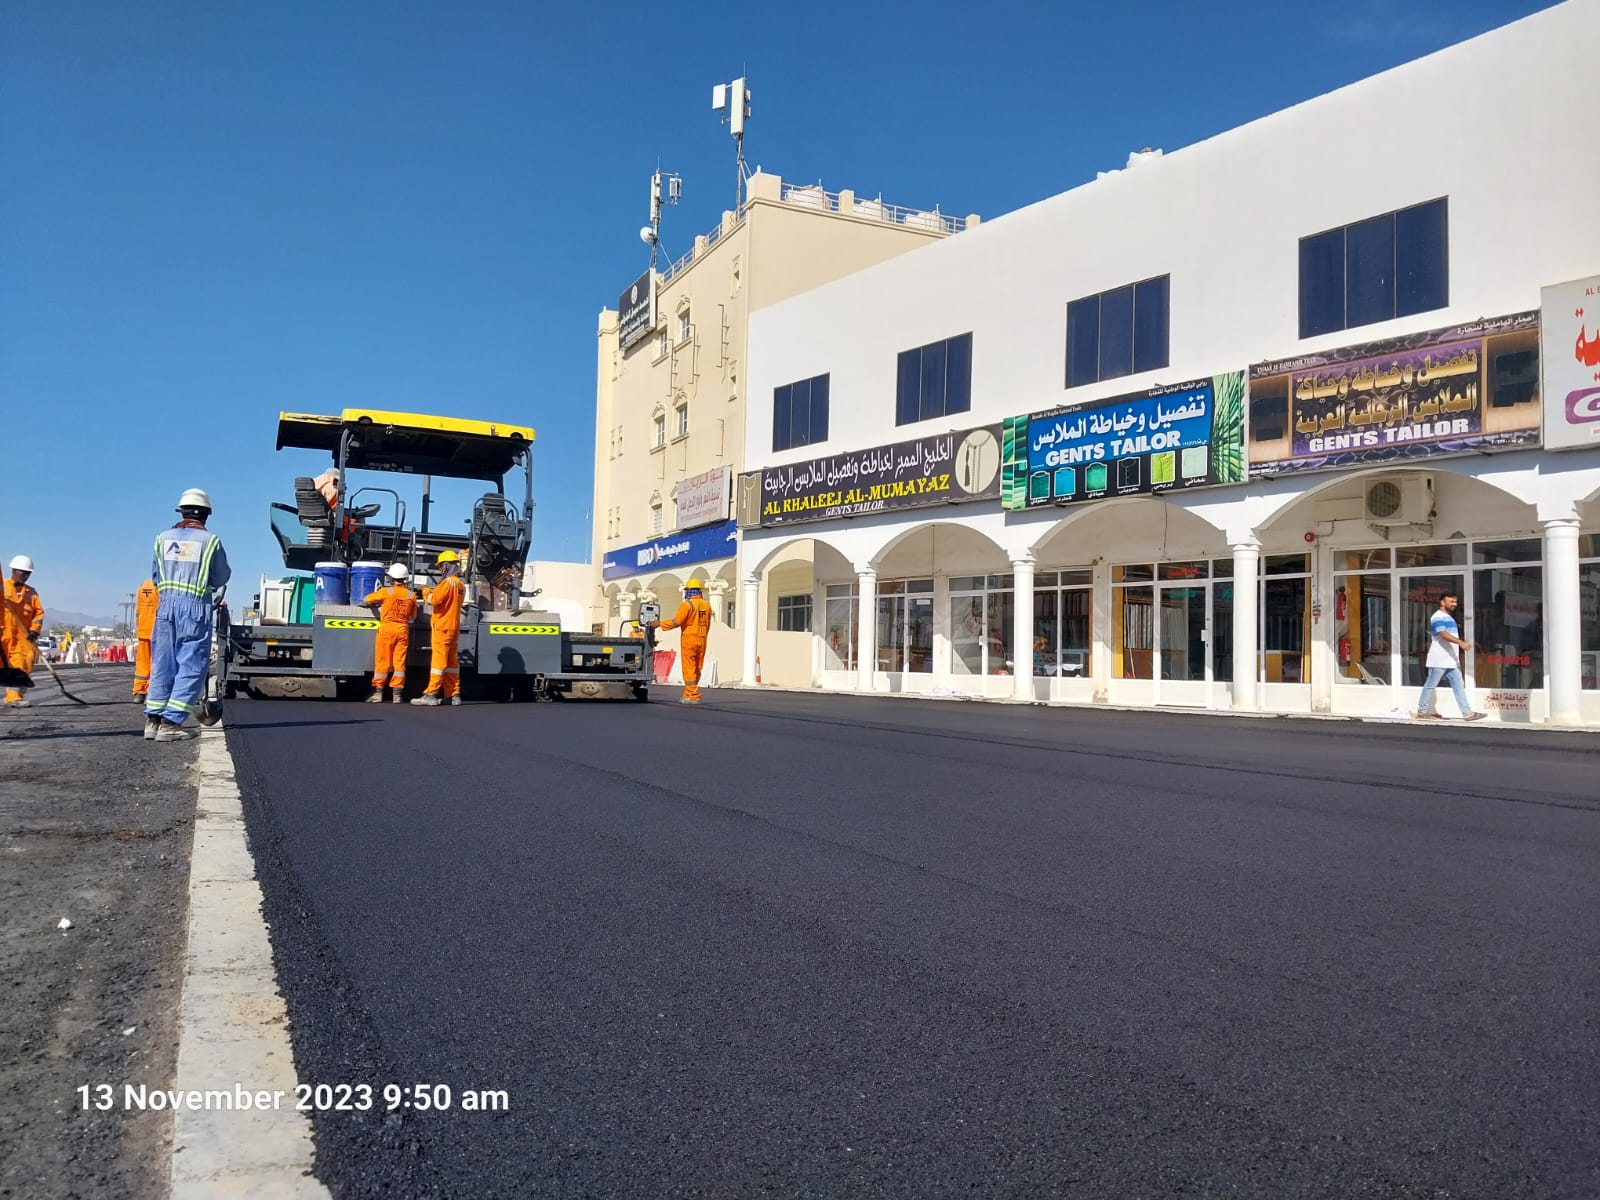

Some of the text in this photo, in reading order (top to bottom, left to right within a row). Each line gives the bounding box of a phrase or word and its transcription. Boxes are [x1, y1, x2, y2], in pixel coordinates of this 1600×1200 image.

[1352, 360, 1413, 394] وخياطة
[1417, 348, 1477, 387] تفصيل
[1295, 402, 1346, 438] العربية
[1413, 382, 1478, 423] الملابس
[1033, 394, 1206, 452] تفصيل وخياطة الملابس
[1309, 418, 1469, 453] GENTS TAILOR
[923, 436, 954, 477] الخليج
[1045, 430, 1181, 467] GENTS TAILOR
[794, 460, 827, 492] الملابس
[827, 456, 859, 487] وتفصيل
[763, 473, 951, 516] AL KHALEEJ AL-MUMAYAZ
[825, 499, 885, 517] GENTS TAILOR
